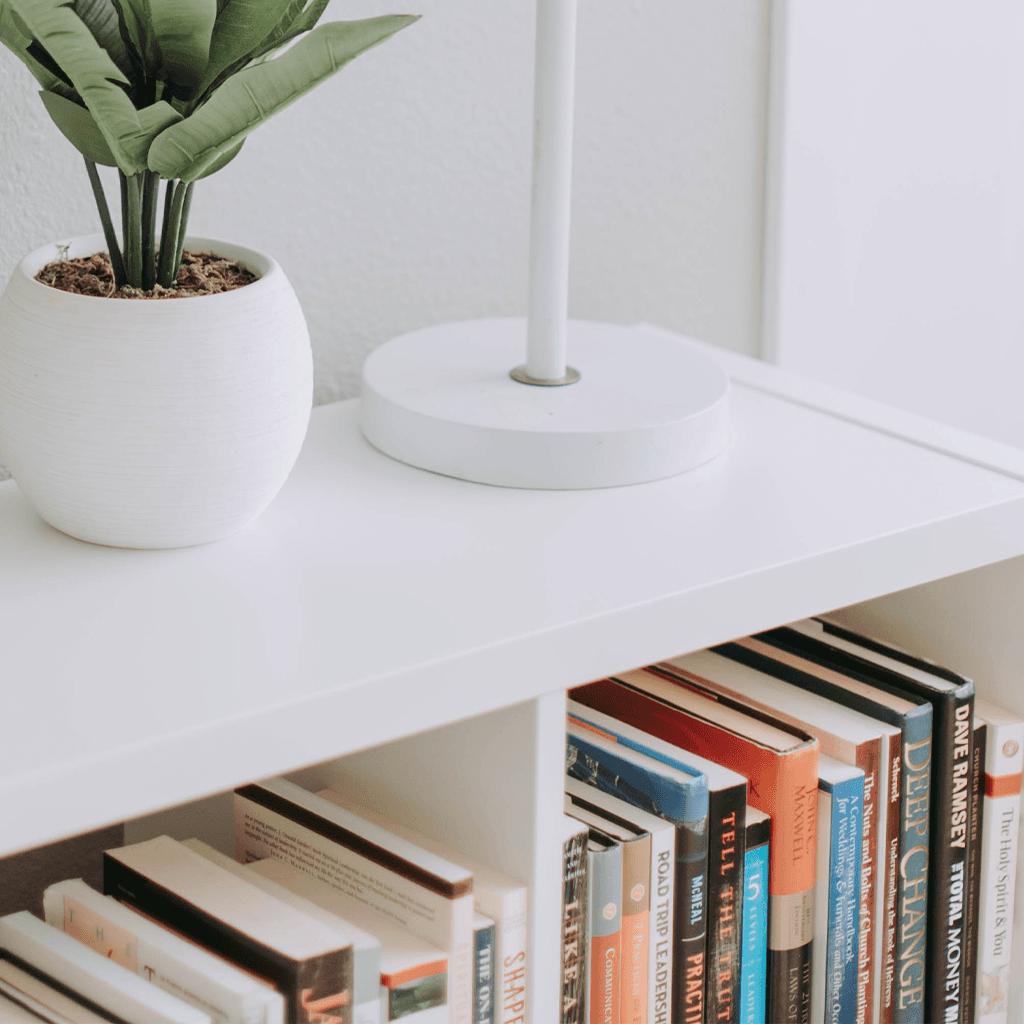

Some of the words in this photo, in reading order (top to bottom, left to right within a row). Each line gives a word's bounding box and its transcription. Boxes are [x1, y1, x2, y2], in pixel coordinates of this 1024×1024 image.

[952, 703, 970, 760] DAVE
[864, 772, 875, 801] The
[890, 756, 900, 803] Schenck
[904, 736, 933, 836] DEEP
[972, 747, 980, 792] CHURCH
[793, 785, 807, 866] MAXWELL
[836, 797, 850, 814] for
[863, 802, 873, 836] Nuts
[950, 763, 969, 849] RAMSEY
[1001, 808, 1014, 835] The
[720, 811, 736, 876] TELL
[835, 817, 849, 878] Weddings
[845, 806, 859, 896] Contemporary
[862, 839, 872, 864] and
[997, 838, 1012, 872] Holy
[656, 849, 671, 897] ROAD
[747, 873, 760, 901] 5
[861, 866, 872, 901] Bolts
[886, 837, 898, 909] Understanding
[689, 874, 704, 925] McNEAL
[719, 885, 735, 940] THE
[859, 903, 870, 915] of
[948, 869, 964, 926] TOTAL
[995, 874, 1010, 914] Spirit
[655, 898, 670, 937] TRIP
[846, 898, 857, 964] Handbook
[887, 910, 896, 927] the
[899, 844, 930, 1010] CHANGE
[995, 917, 1007, 928] &
[564, 899, 579, 985] LIKE
[833, 950, 843, 969] and
[859, 917, 871, 969] Church
[886, 928, 895, 951] Book
[886, 953, 894, 964] of
[993, 930, 1007, 957] You
[479, 944, 491, 983] THE
[945, 927, 962, 1002] MONEY
[604, 947, 616, 1024] COMMUNICA
[685, 952, 704, 1024] PRACTI
[789, 966, 799, 1002] LAWS
[832, 972, 842, 1001] Other
[884, 965, 894, 1009] Hebrews
[563, 995, 578, 1014] A
[788, 1004, 798, 1021] OF
[944, 1003, 959, 1024] M
